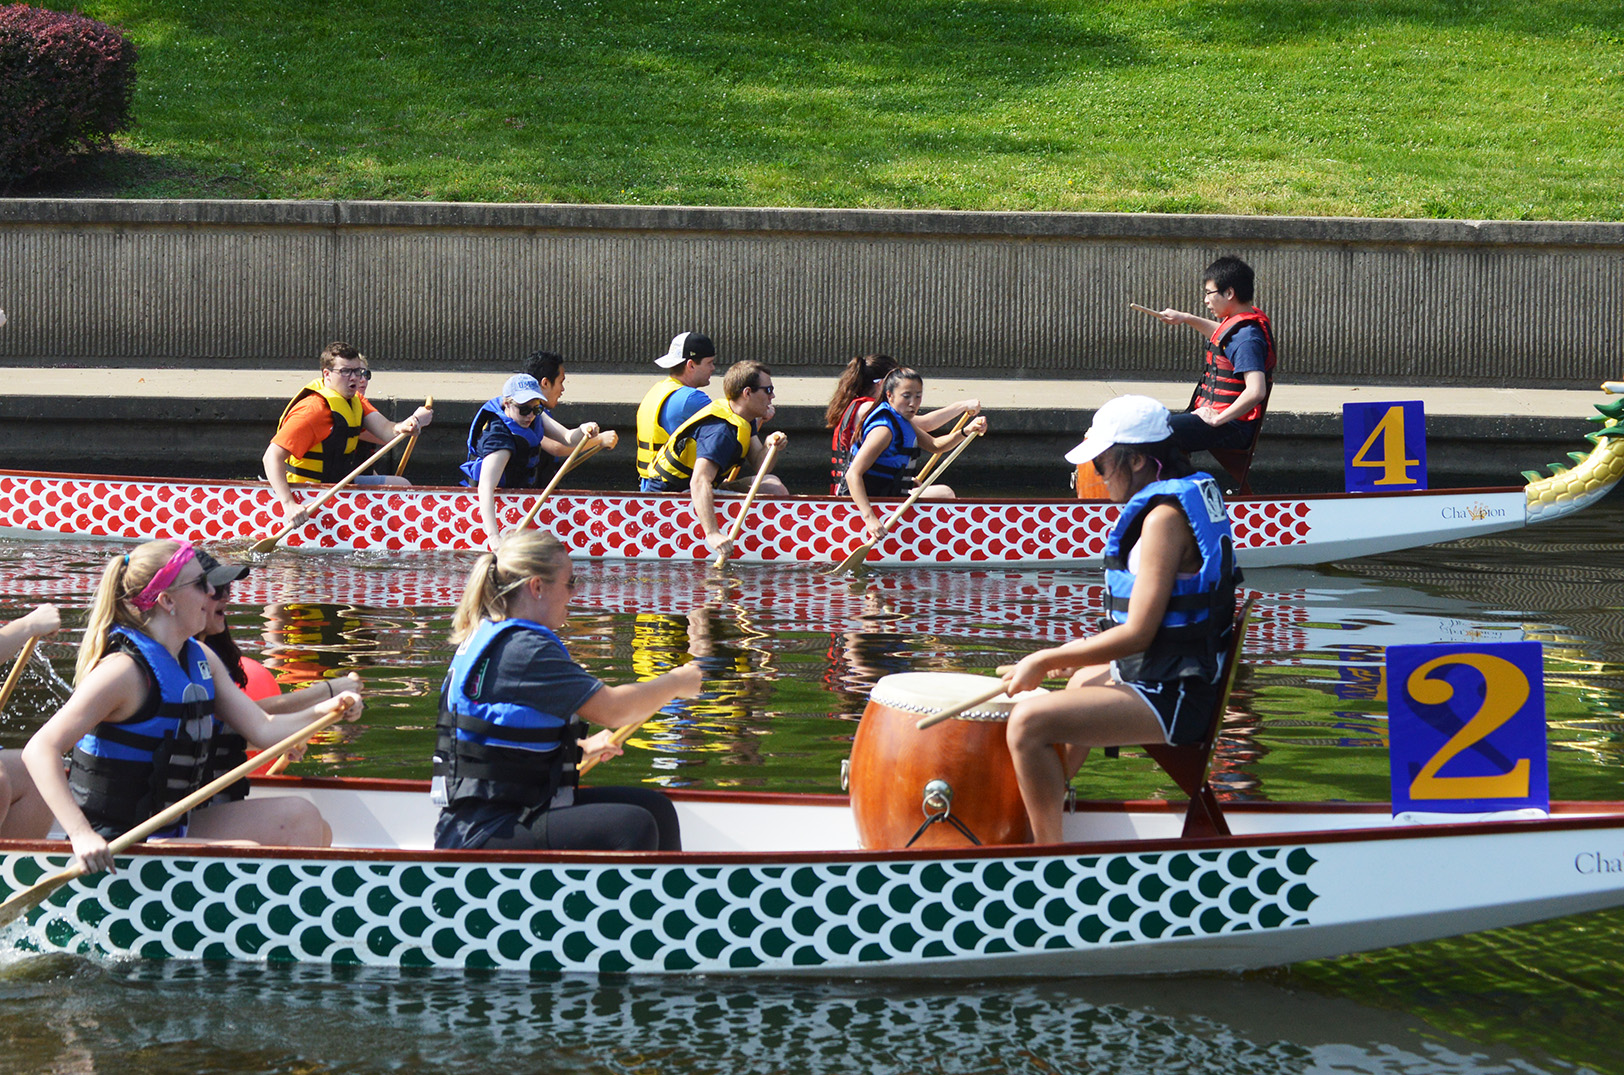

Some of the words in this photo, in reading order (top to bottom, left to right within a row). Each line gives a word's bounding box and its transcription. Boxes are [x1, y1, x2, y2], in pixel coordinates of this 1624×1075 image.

[1352, 406, 1420, 485] 4
[1441, 505, 1506, 520] Chapion
[1407, 652, 1531, 800] 2
